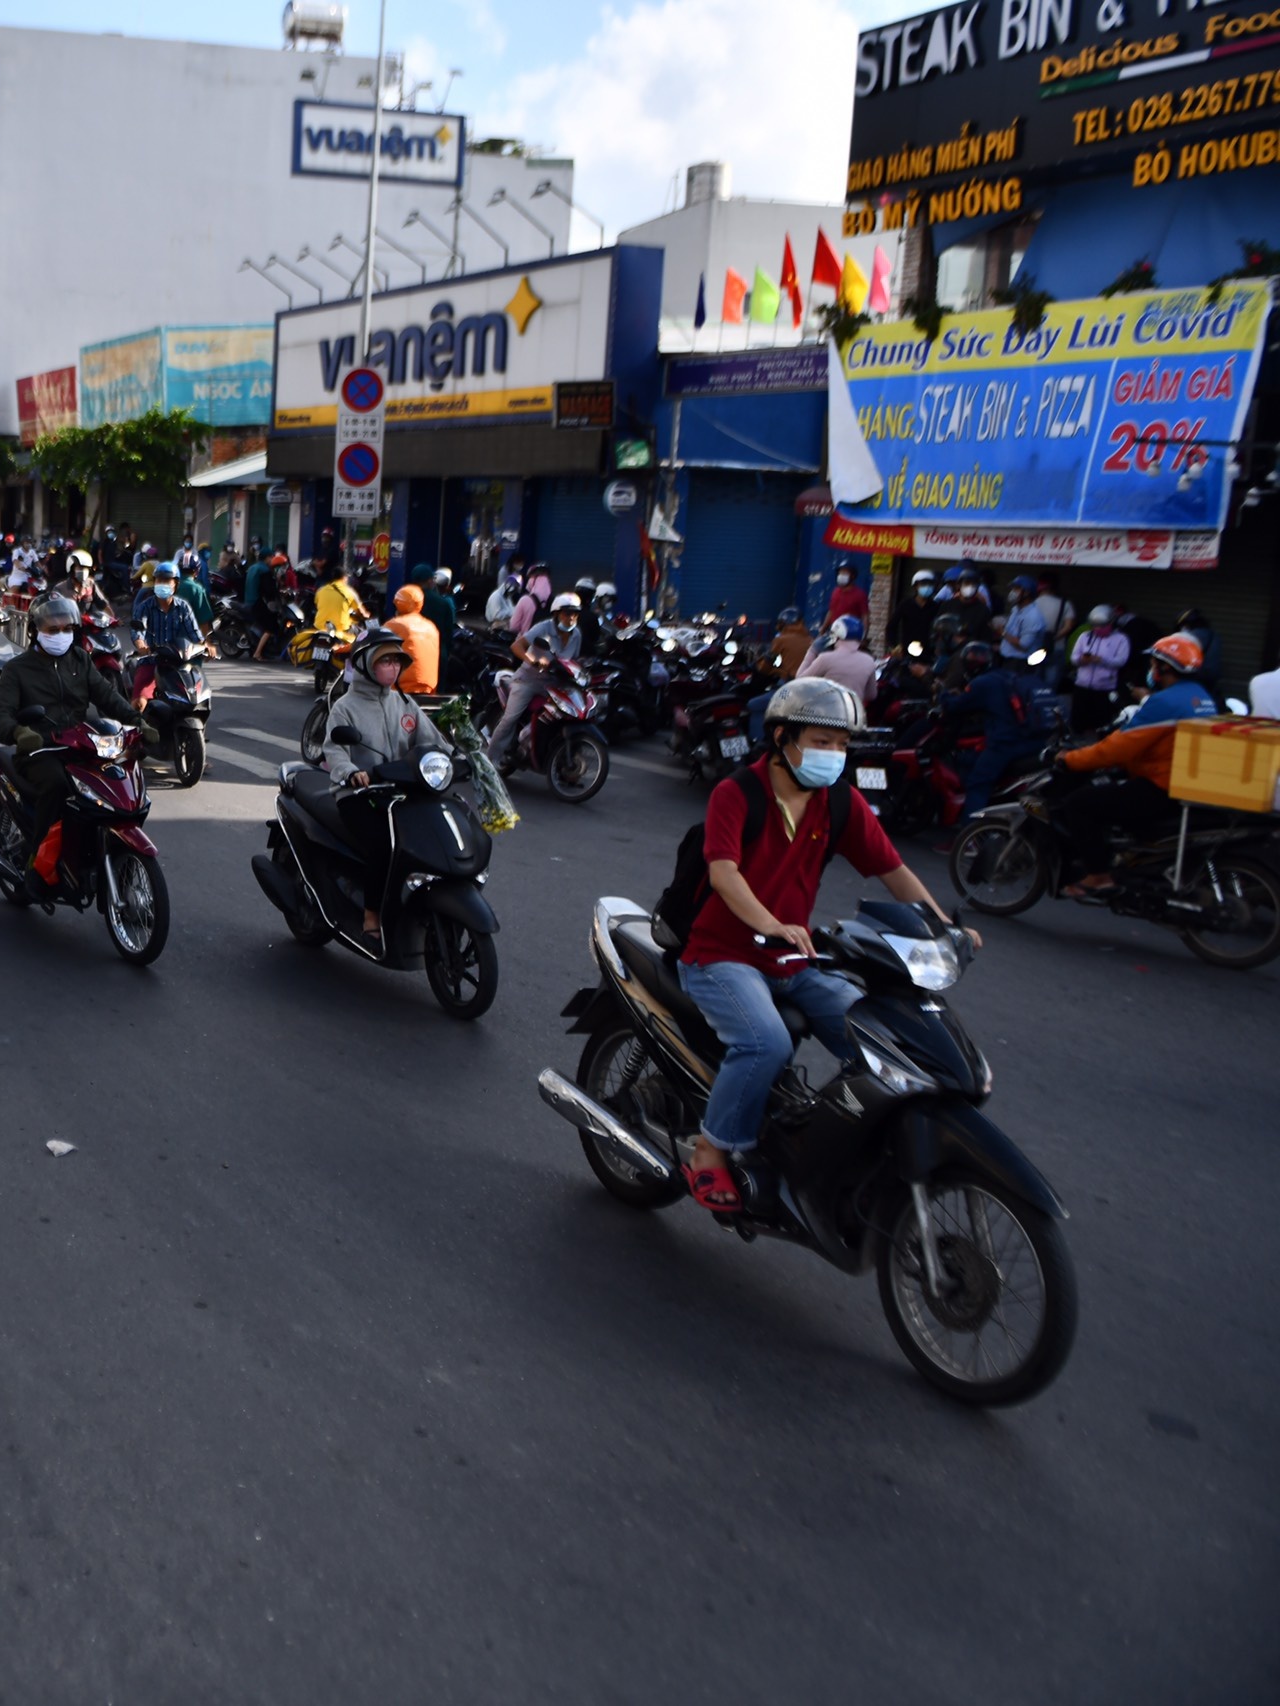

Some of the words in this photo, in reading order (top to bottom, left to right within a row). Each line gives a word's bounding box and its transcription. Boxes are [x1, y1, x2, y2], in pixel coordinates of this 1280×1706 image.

[857, 1, 981, 98] STEAK
[999, 0, 1072, 60] BIN
[1040, 32, 1180, 84] Delicious
[848, 154, 884, 192] GIAO
[886, 142, 933, 183] HÀNG
[936, 120, 984, 178] MIỄN
[986, 117, 1020, 163] PHÍ
[1133, 140, 1171, 188] BÒ
[842, 198, 876, 238] BÒ
[882, 188, 923, 230] MỸ
[929, 175, 1023, 225] NƯỚNG
[848, 337, 932, 371] Chung
[939, 327, 992, 361] Sức
[1067, 313, 1127, 350] Lùi
[1133, 302, 1241, 345] Covid
[1114, 357, 1185, 405] GIẢM
[1187, 353, 1238, 400] GIÁ
[915, 382, 975, 445] STEAK
[977, 380, 1020, 443] BIN
[1015, 396, 1031, 438] &
[1033, 374, 1098, 438] PIZZA
[1102, 417, 1210, 474] 20%
[955, 461, 1004, 509] HÀNG
[832, 528, 876, 547] Khách
[877, 530, 910, 553] Hàng
